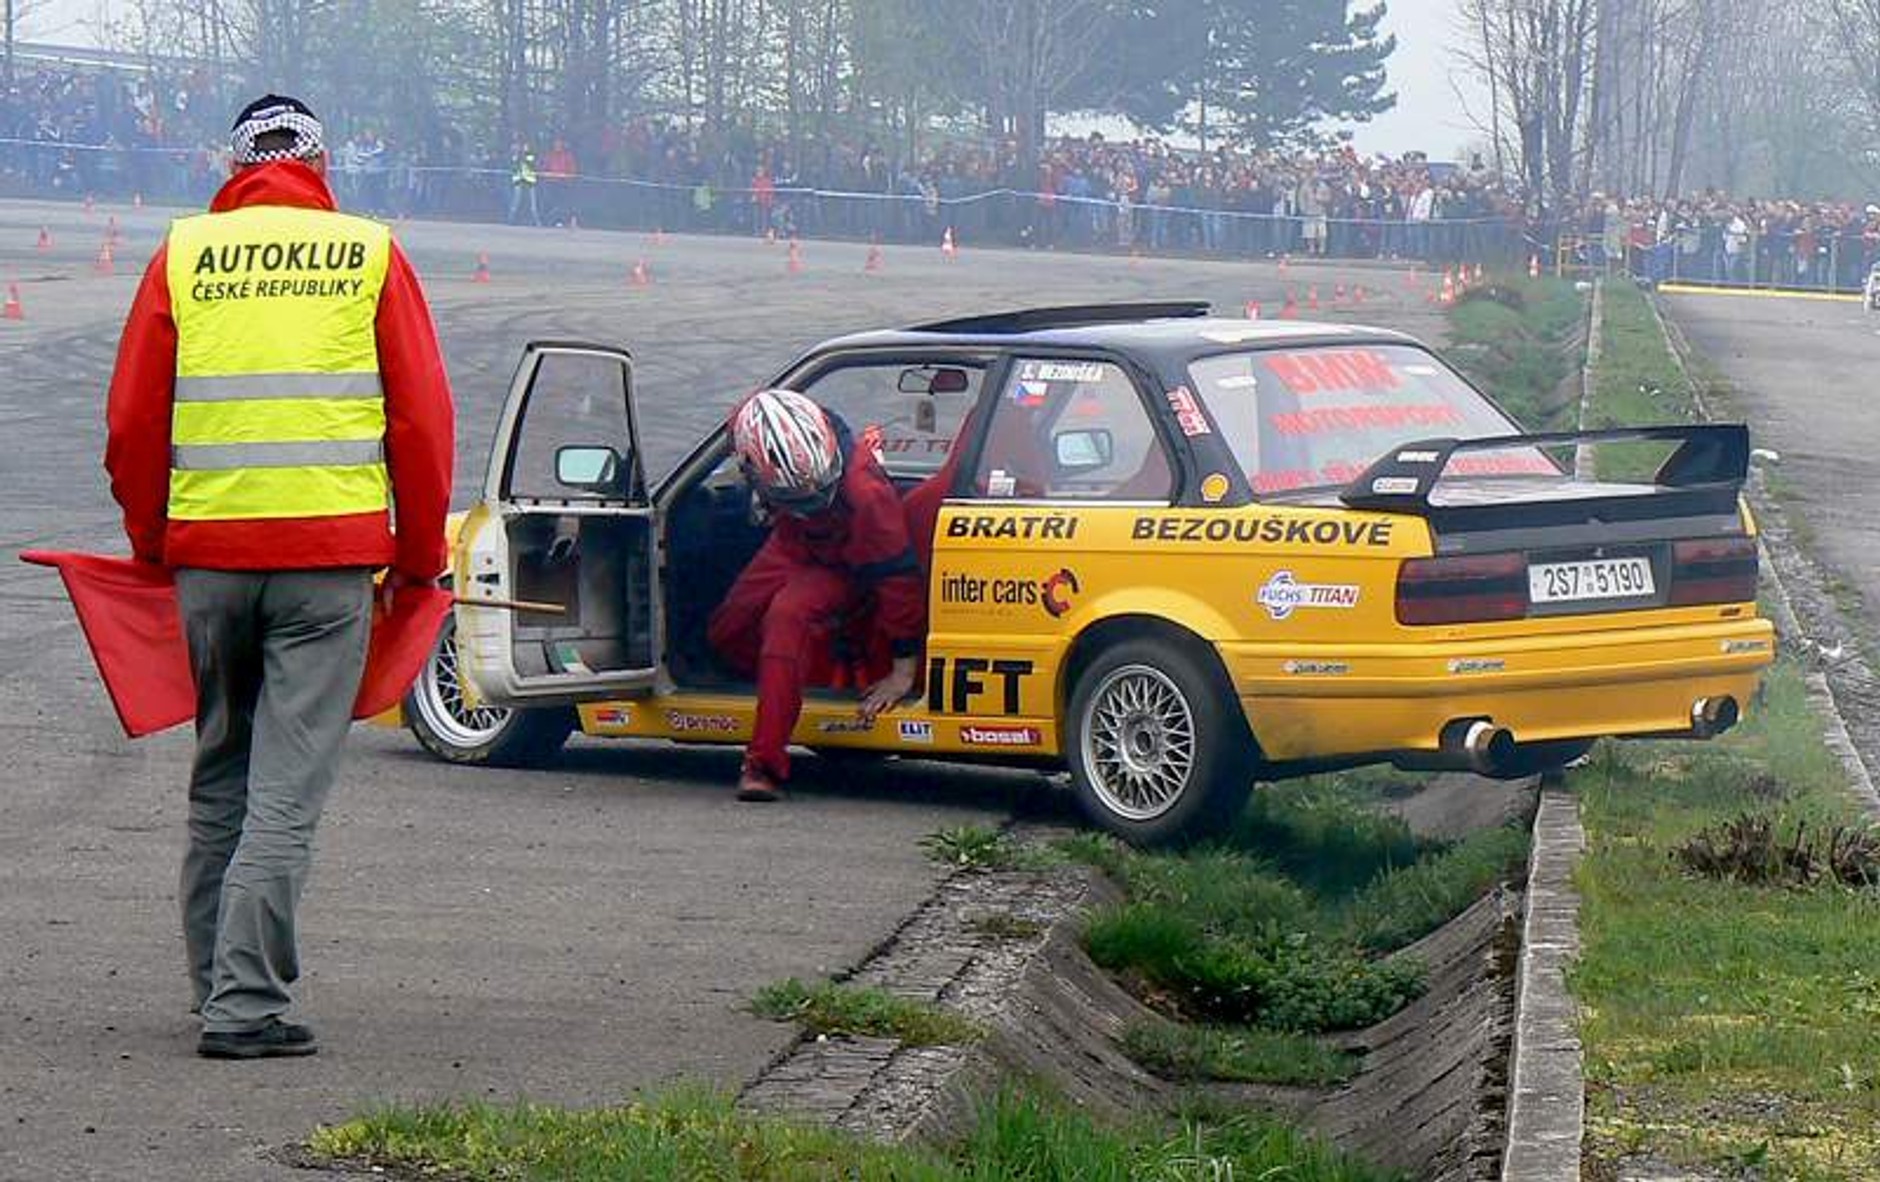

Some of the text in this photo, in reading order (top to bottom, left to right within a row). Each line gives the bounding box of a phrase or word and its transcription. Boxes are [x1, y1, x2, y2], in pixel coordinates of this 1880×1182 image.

[194, 242, 366, 274] AUTOKLUB
[192, 279, 364, 301] ČESKÉ REPUBLIKY
[946, 512, 1393, 546] BRATŘI BEZOUŠKOVÉ
[941, 571, 1038, 605] inter cars
[1308, 587, 1356, 604] TITAN
[1543, 562, 1644, 597] 2S7 5190
